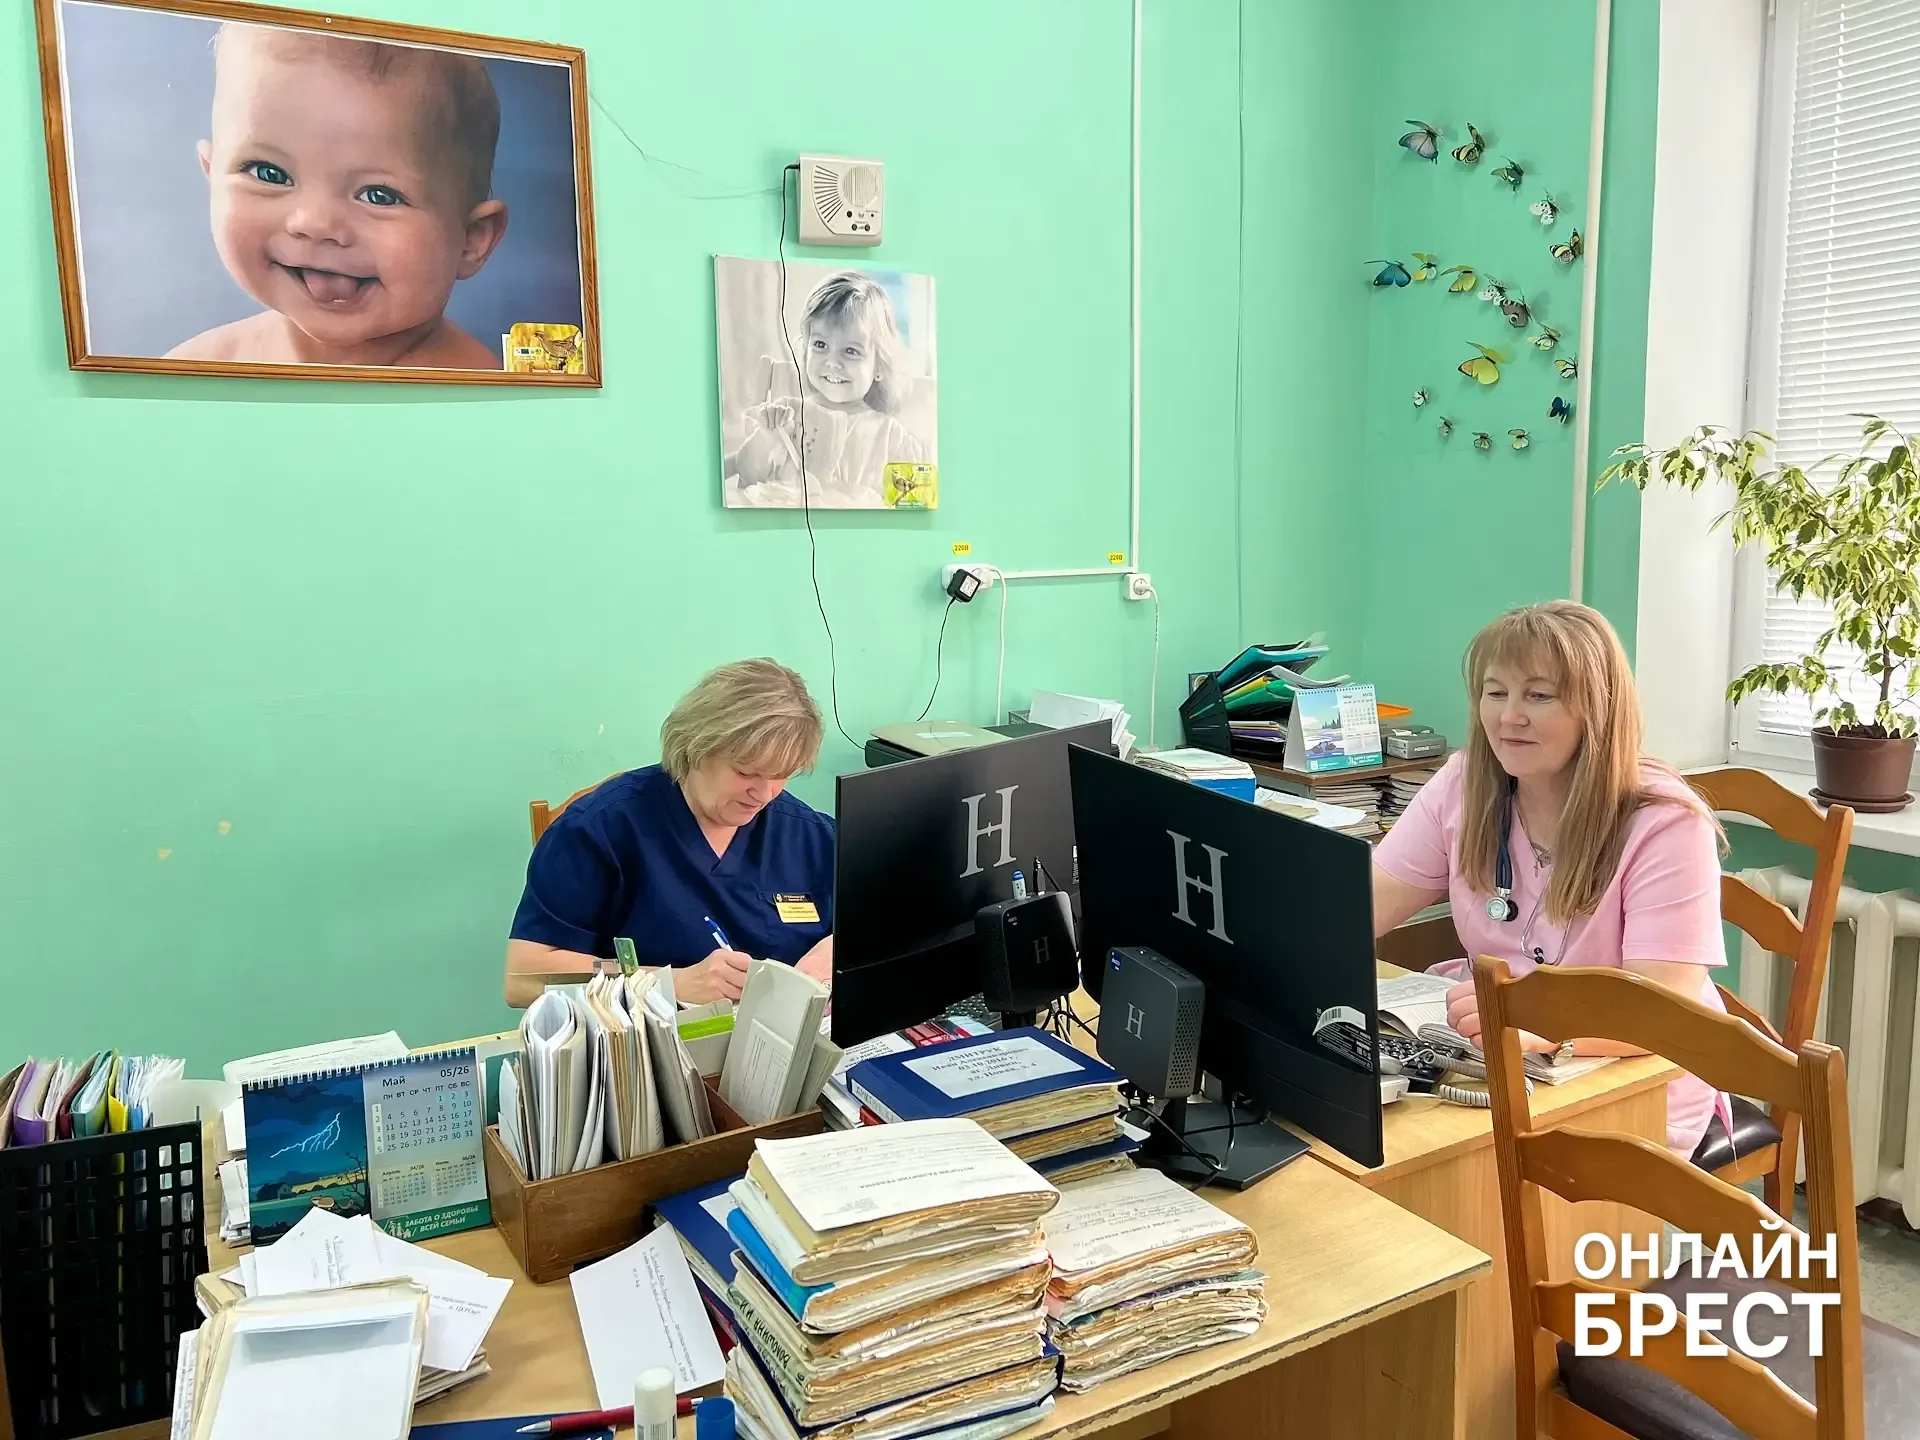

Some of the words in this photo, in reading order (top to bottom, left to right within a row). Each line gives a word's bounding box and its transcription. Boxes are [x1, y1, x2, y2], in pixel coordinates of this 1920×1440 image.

[959, 785, 1019, 878] H
[1166, 829, 1234, 945] H
[1032, 936, 1051, 964] H
[1125, 1002, 1146, 1040] H
[948, 1047, 1002, 1062] ДМИТРУК
[382, 1075, 405, 1087] Май
[440, 1066, 469, 1078] 05/26
[932, 1062, 958, 1071] Иван
[405, 1216, 432, 1227] ЗАБОТА
[441, 1205, 479, 1220] ЗДОРОВЬЕ
[420, 1223, 439, 1232] ВСЕЙ
[440, 1216, 465, 1228] СЕМЬИ
